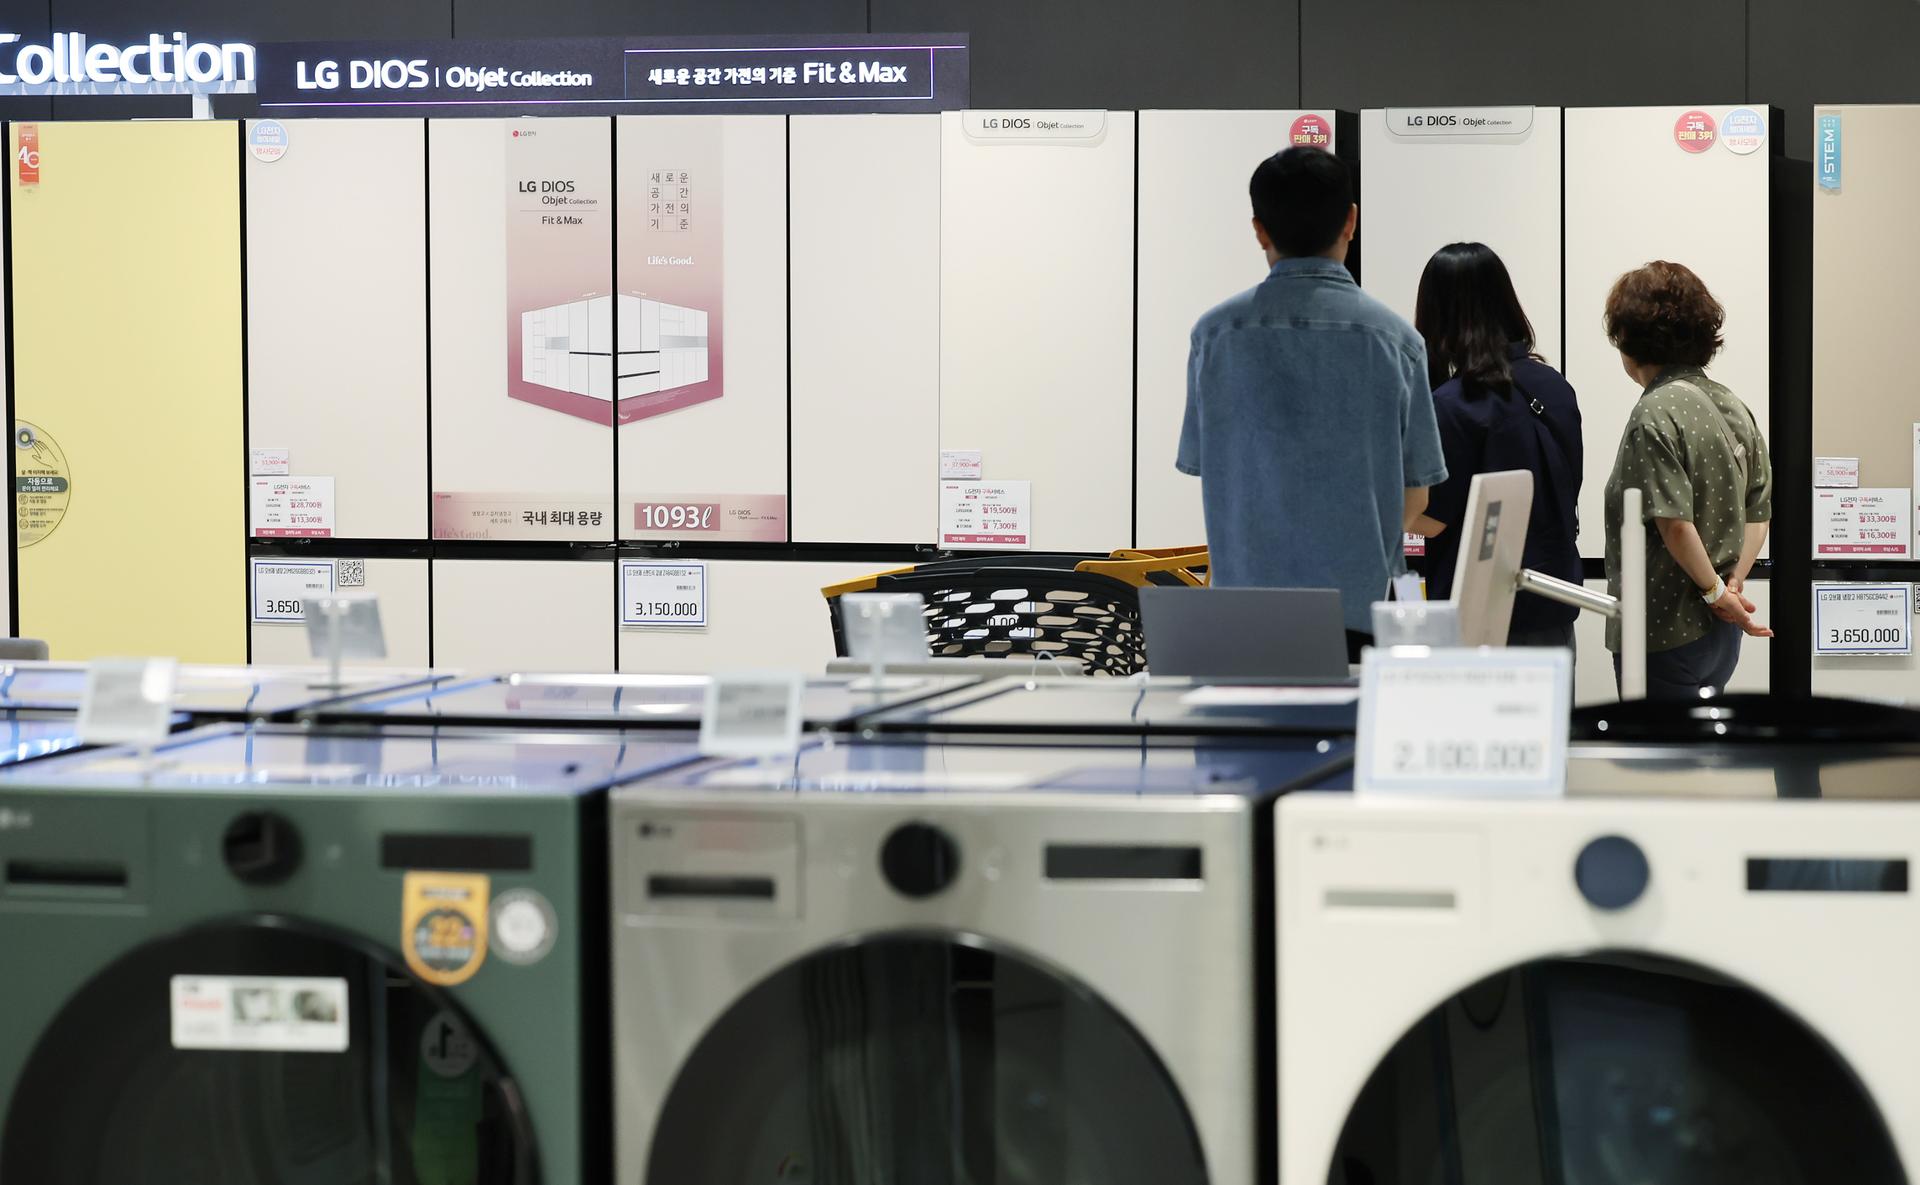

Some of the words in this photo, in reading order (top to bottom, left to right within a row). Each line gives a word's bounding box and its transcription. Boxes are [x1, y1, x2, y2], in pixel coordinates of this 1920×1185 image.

[296, 60, 339, 90] LG
[349, 59, 429, 89] DIOS
[446, 66, 508, 92] Objet
[510, 70, 592, 87] Collection
[648, 68, 691, 85] 새로운
[693, 68, 721, 85] 공간
[723, 67, 766, 85] 가전의
[768, 67, 797, 84] 기준
[803, 62, 837, 84] Fit
[838, 62, 857, 84] &
[858, 61, 907, 83] Max
[983, 118, 998, 129] LG
[1002, 118, 1030, 129] DIOS
[1036, 120, 1059, 131] Objet
[1407, 116, 1423, 126] LG
[1427, 115, 1457, 126] DIOS
[1462, 117, 1486, 128] Objet
[1686, 121, 1705, 131] 구독
[1301, 125, 1319, 134] 구독
[1312, 134, 1327, 144] 3위
[1824, 129, 1835, 173] STEM
[519, 181, 537, 193] LG
[541, 180, 575, 193] DIOS
[541, 196, 567, 207] Objet
[541, 216, 555, 225] Fit
[556, 216, 563, 225] &
[564, 216, 583, 225] Max
[647, 255, 668, 265] Life's
[669, 255, 695, 265] Good.
[27, 477, 53, 486] 자동으로
[522, 511, 547, 526] 국내
[550, 511, 575, 526] 최대
[577, 511, 603, 526] 용량
[266, 600, 304, 613] 3,650,
[635, 602, 697, 617] 3,150,000
[1831, 628, 1900, 643] 3,650,000
